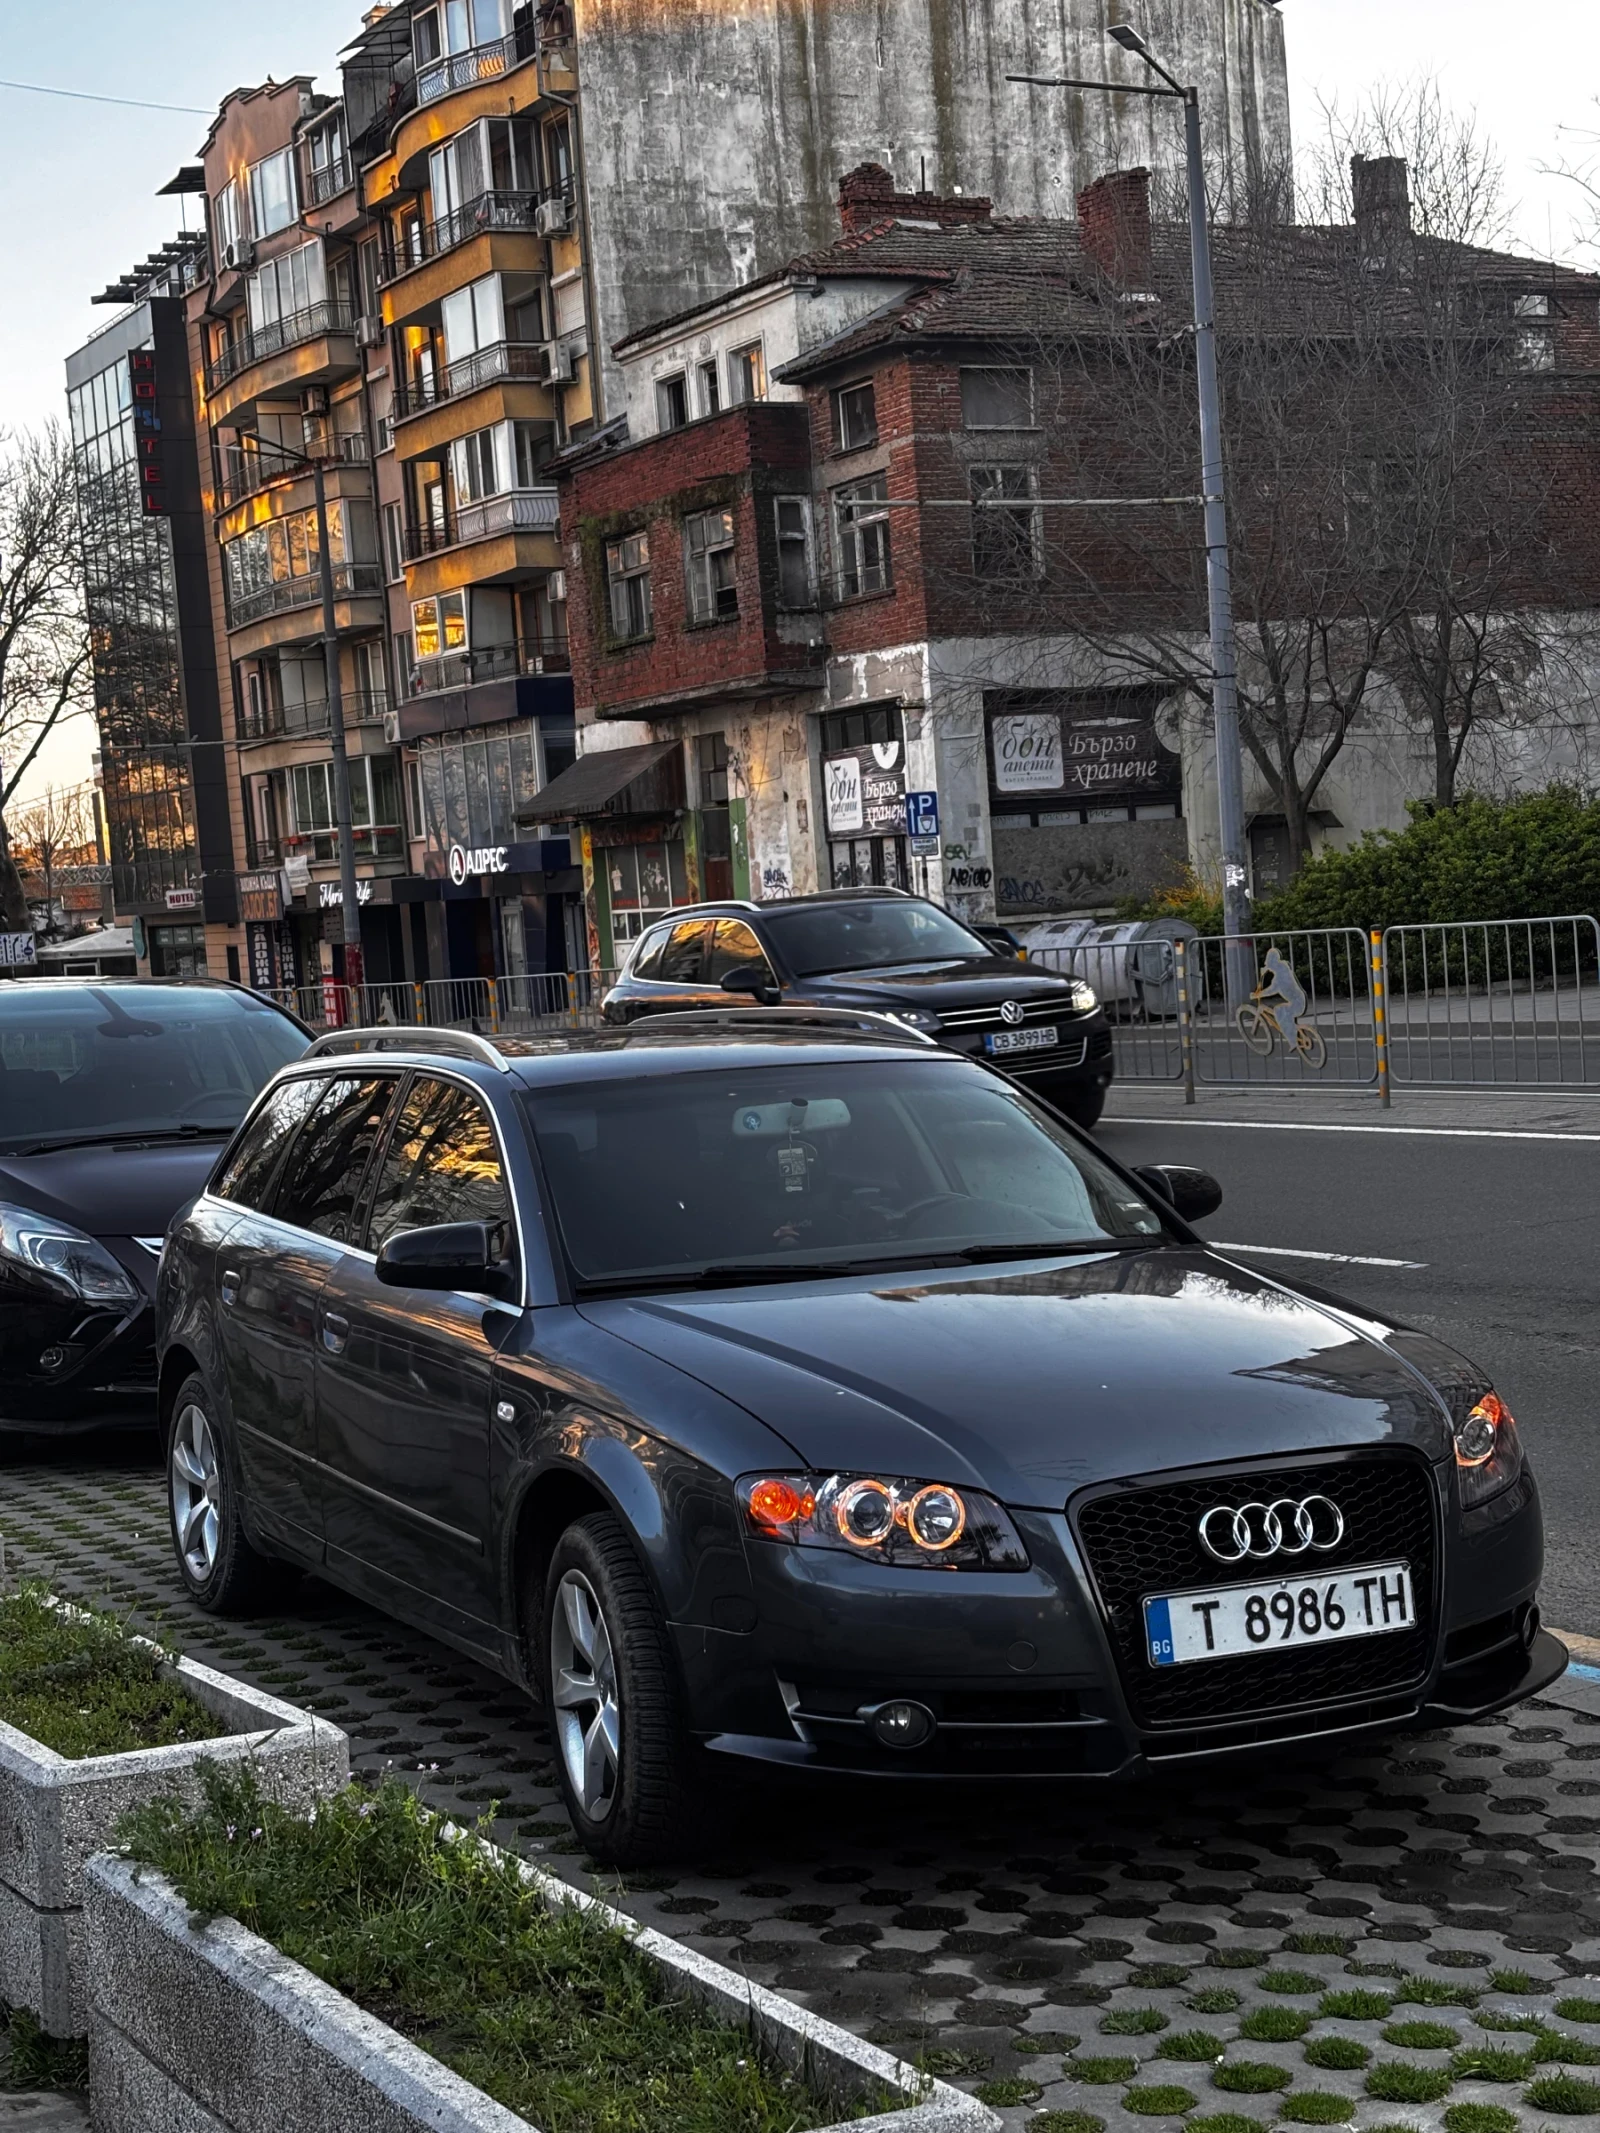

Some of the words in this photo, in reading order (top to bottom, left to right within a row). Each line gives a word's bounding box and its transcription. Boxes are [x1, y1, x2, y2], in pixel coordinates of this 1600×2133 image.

[1069, 732, 1136, 761] Бързо
[1071, 760, 1157, 789] хранене
[863, 778, 898, 804] Бързо
[865, 804, 906, 829] хранен
[918, 795, 932, 814] P
[466, 847, 508, 874] АДРЕС
[169, 893, 195, 904] HOTEL
[253, 924, 270, 985] ЗАЛОЖНА
[993, 1034, 1010, 1049] CB
[1011, 1031, 1039, 1047] 3899
[1192, 1600, 1220, 1650] T
[1245, 1583, 1346, 1643] 8986
[1354, 1572, 1407, 1626] TH
[1152, 1640, 1171, 1655] BG
